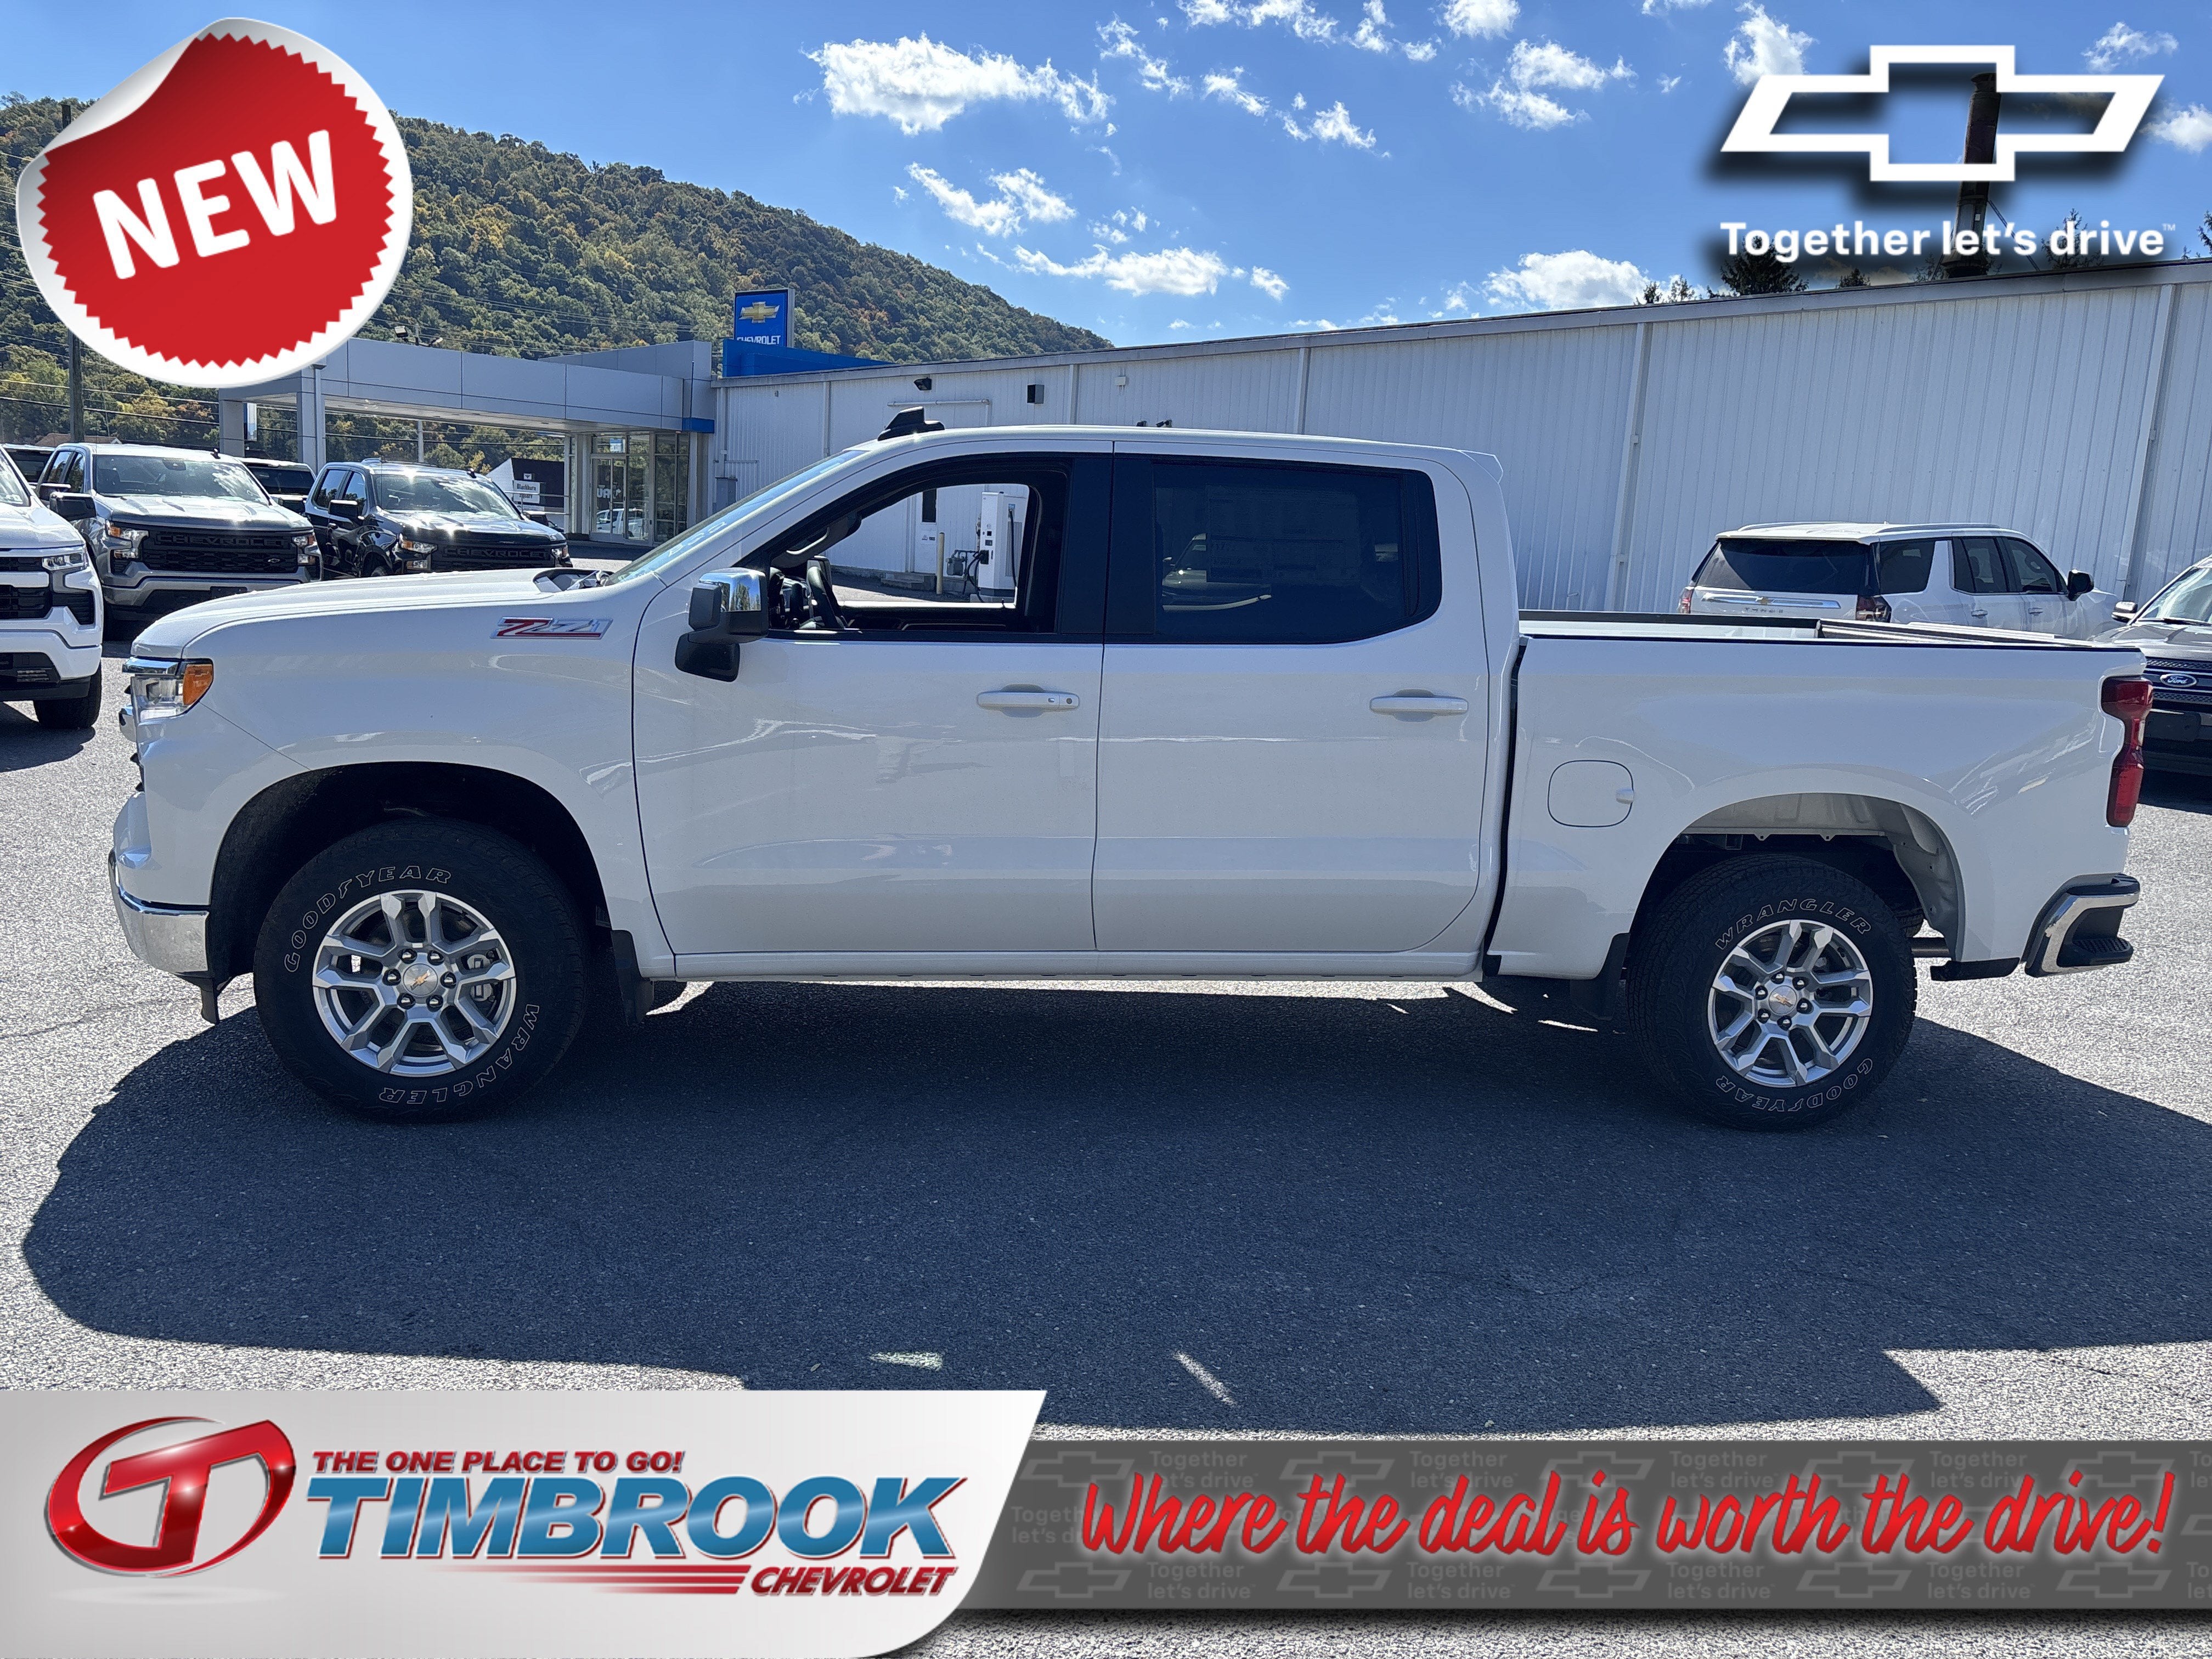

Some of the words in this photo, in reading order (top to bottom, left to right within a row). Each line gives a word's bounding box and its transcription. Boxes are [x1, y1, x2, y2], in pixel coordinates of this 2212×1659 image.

[156, 534, 286, 546] CHEVROLET
[2167, 675, 2188, 684] Ford
[284, 865, 452, 972] GOODYEAR
[1715, 898, 1872, 950] WRANGLER
[379, 1004, 540, 1104] WRANGLER
[1715, 1058, 1873, 1112] GOODYEAR
